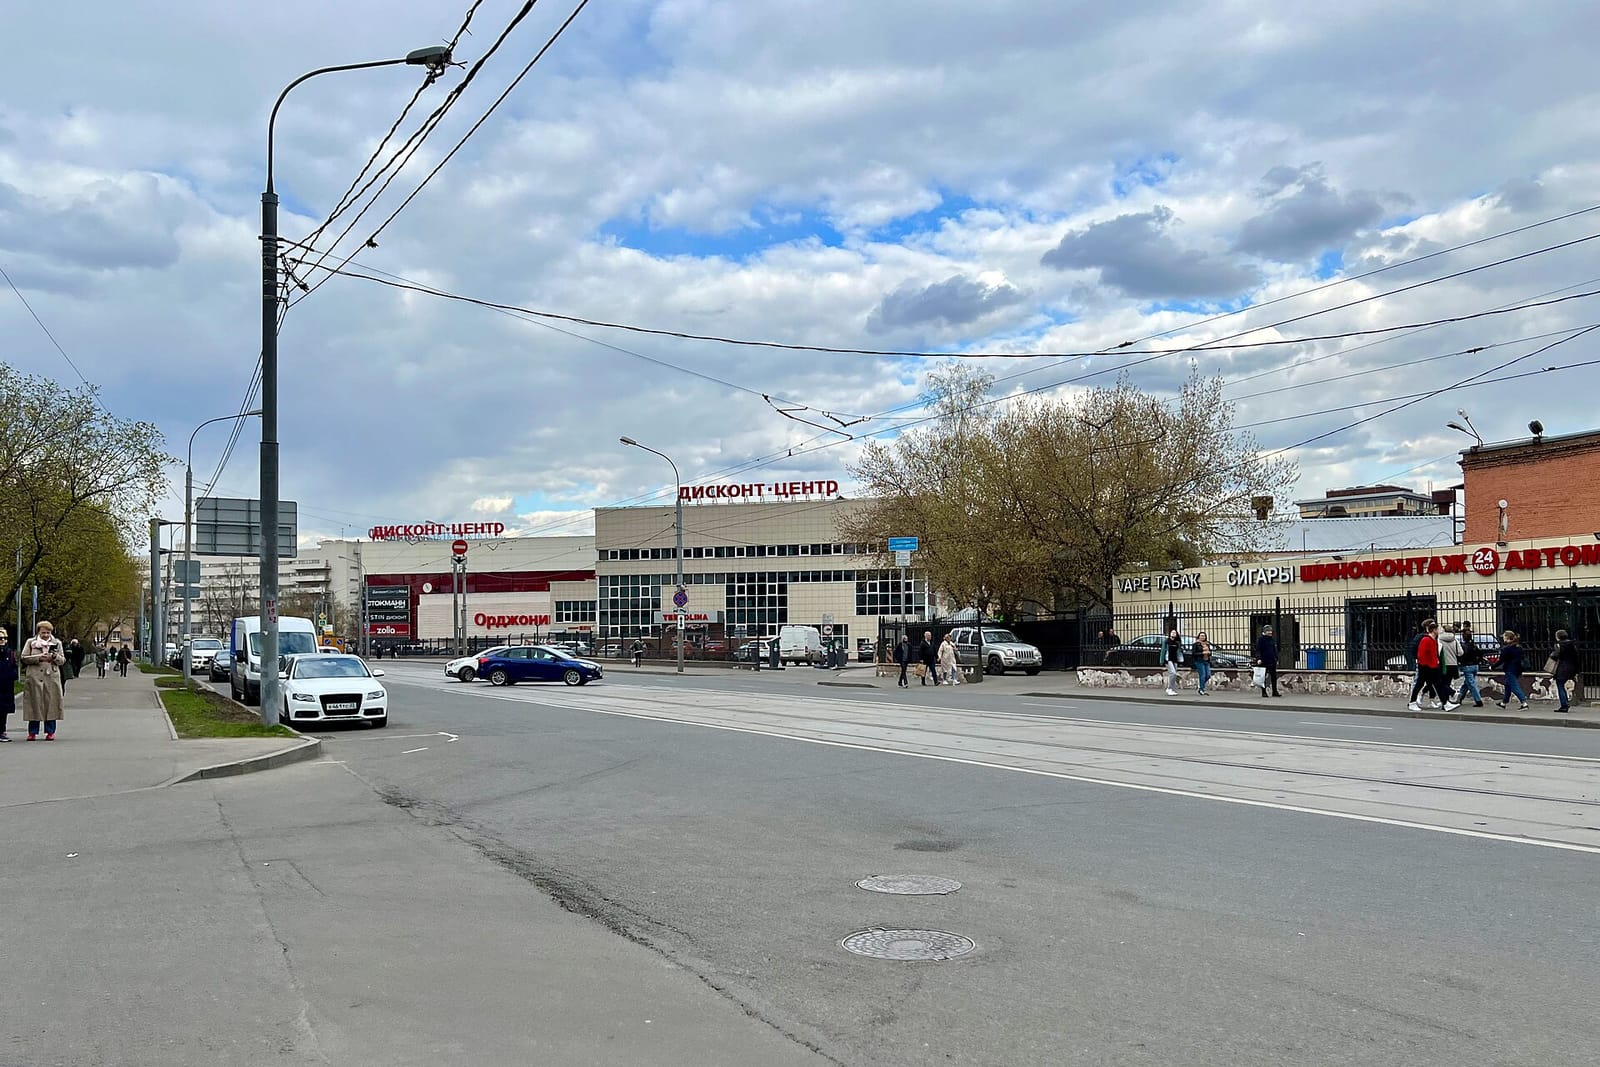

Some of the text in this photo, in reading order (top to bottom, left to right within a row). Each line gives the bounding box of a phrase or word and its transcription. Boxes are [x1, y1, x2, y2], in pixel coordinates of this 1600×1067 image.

[1475, 550, 1494, 563] 24
[1227, 565, 1295, 586] СИГАРЫ
[1300, 553, 1468, 582] ШИНОМОНТАЖ
[1118, 573, 1200, 593] VAPE ТАБАК
[376, 625, 396, 634] zolla
[474, 613, 551, 630] Орджони
